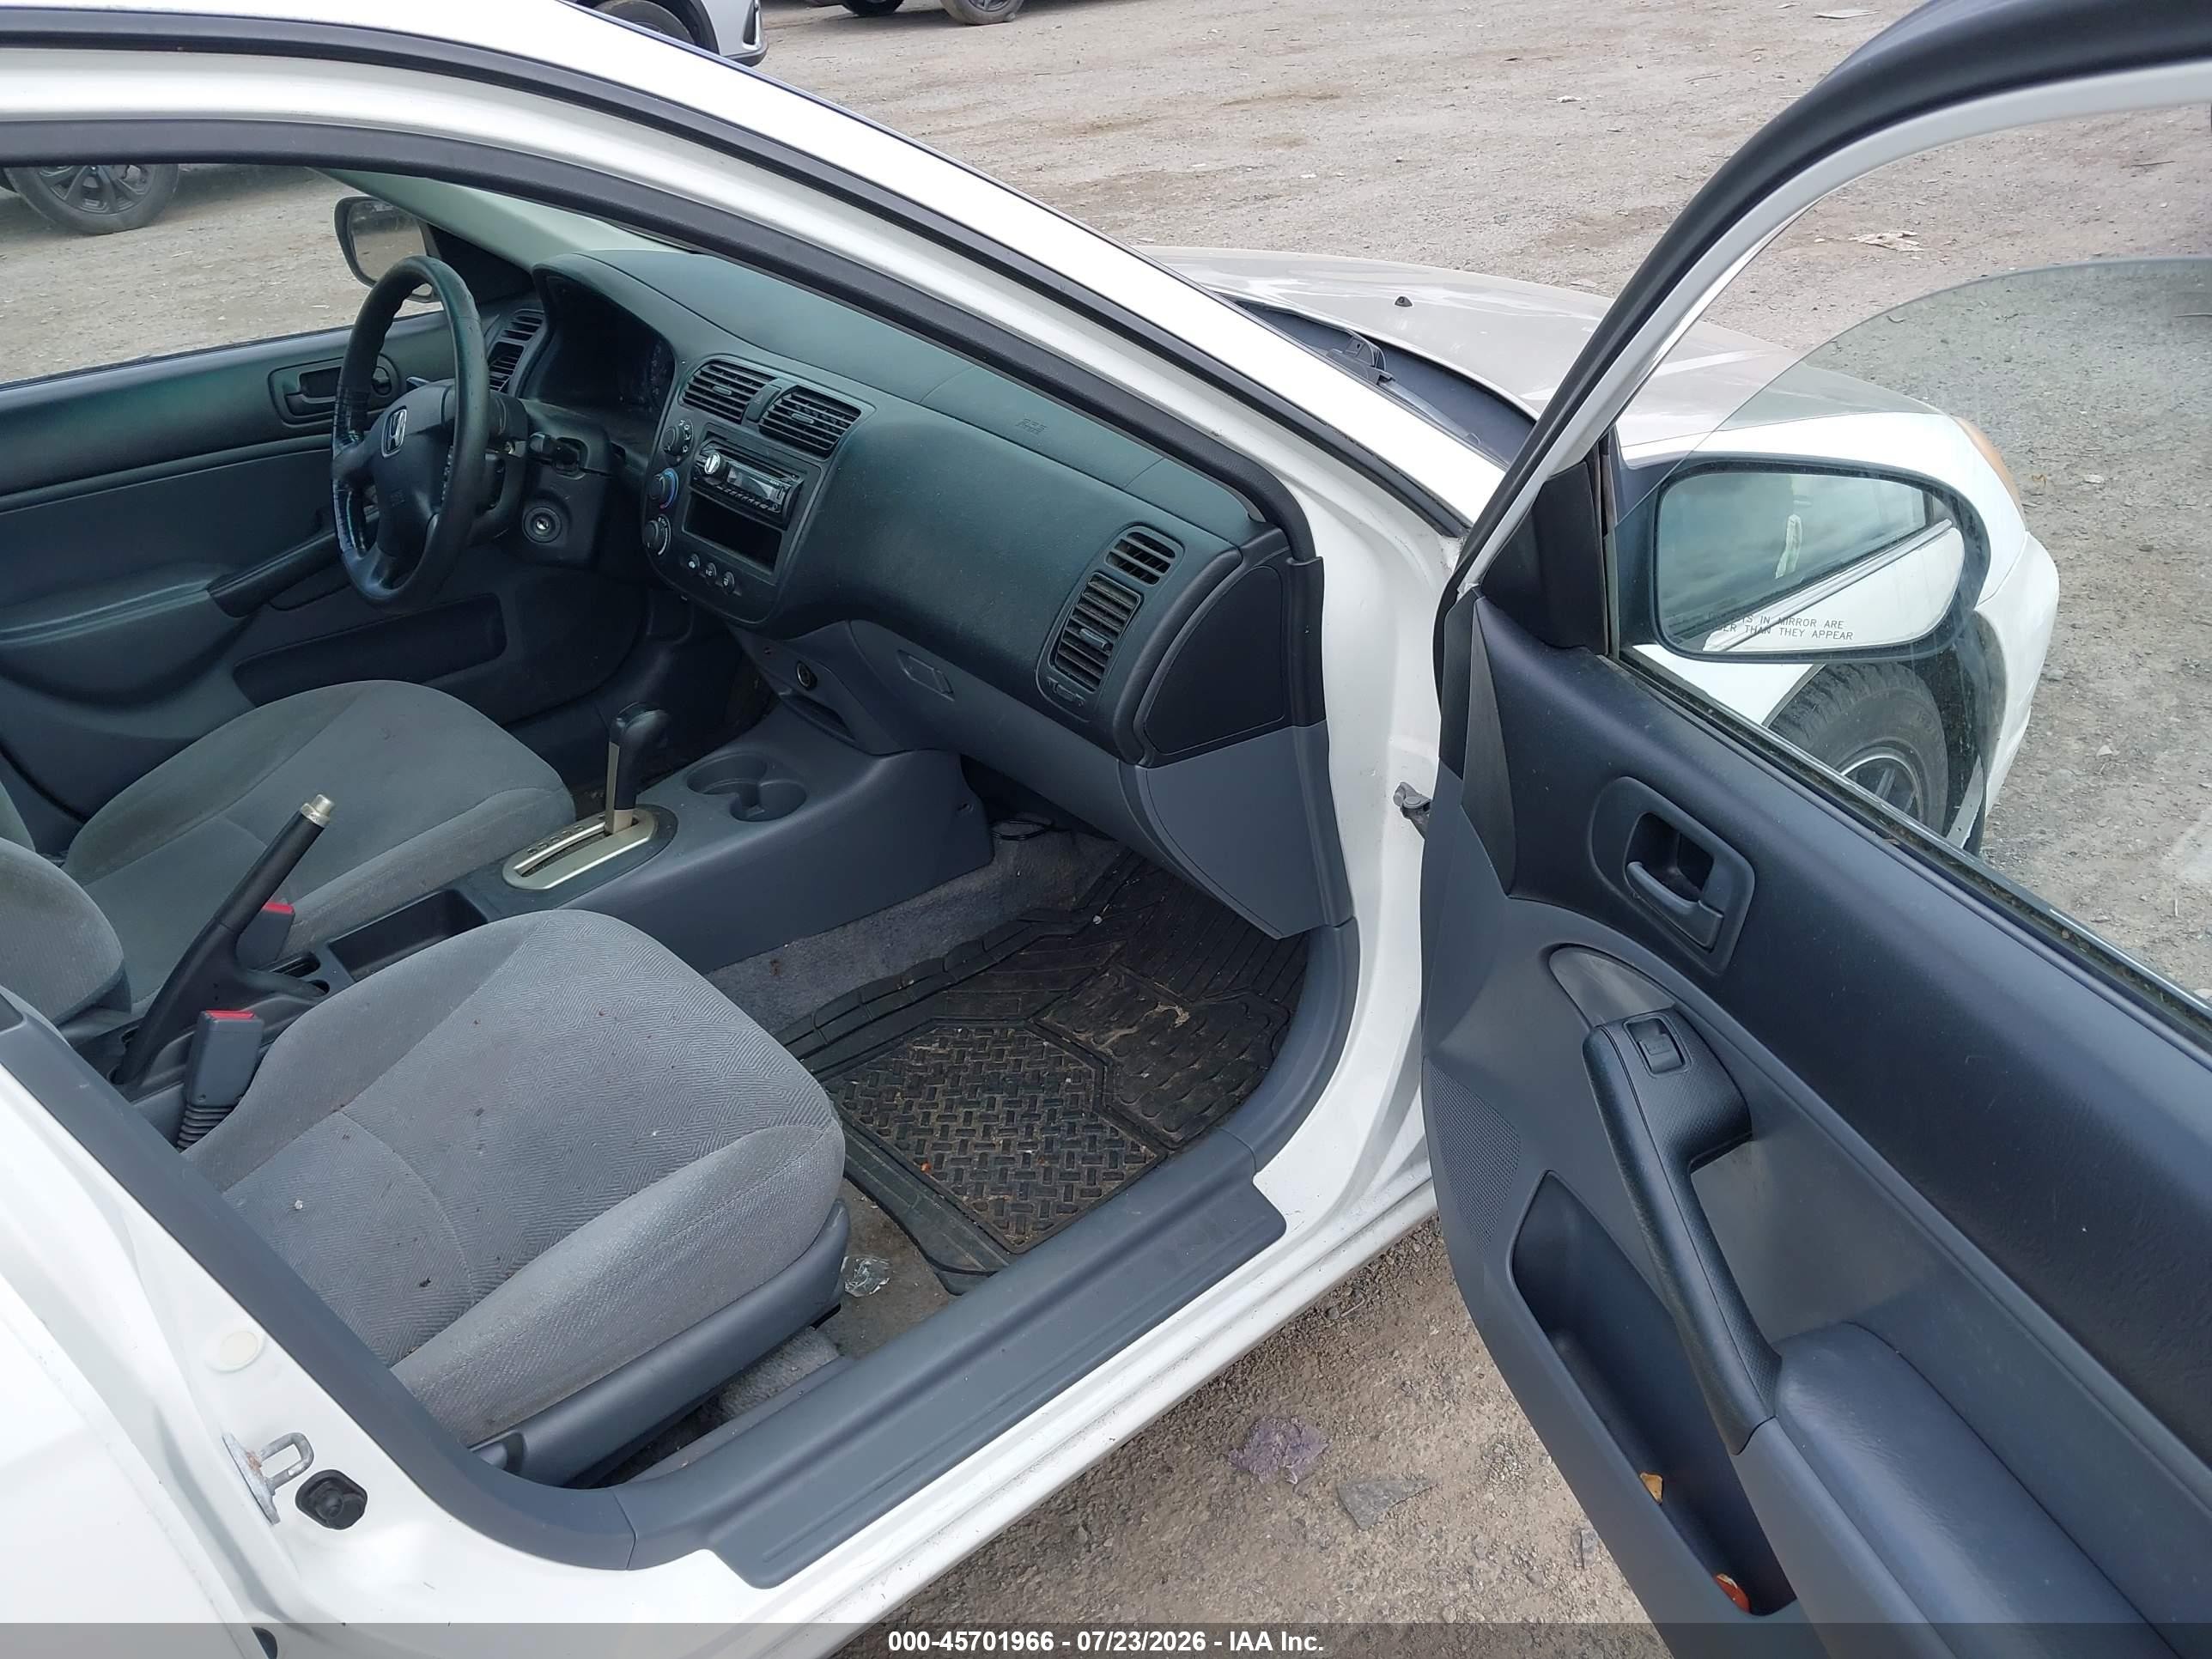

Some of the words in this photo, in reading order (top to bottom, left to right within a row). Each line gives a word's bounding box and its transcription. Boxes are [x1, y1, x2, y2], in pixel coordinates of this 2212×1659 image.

[1759, 616, 1771, 624] IN
[1778, 617, 1817, 627] MIRROR
[1823, 620, 1844, 629] ARE
[1745, 624, 1771, 635] THAN
[1779, 628, 1805, 637] THEY
[1811, 630, 1853, 640] APPEAR
